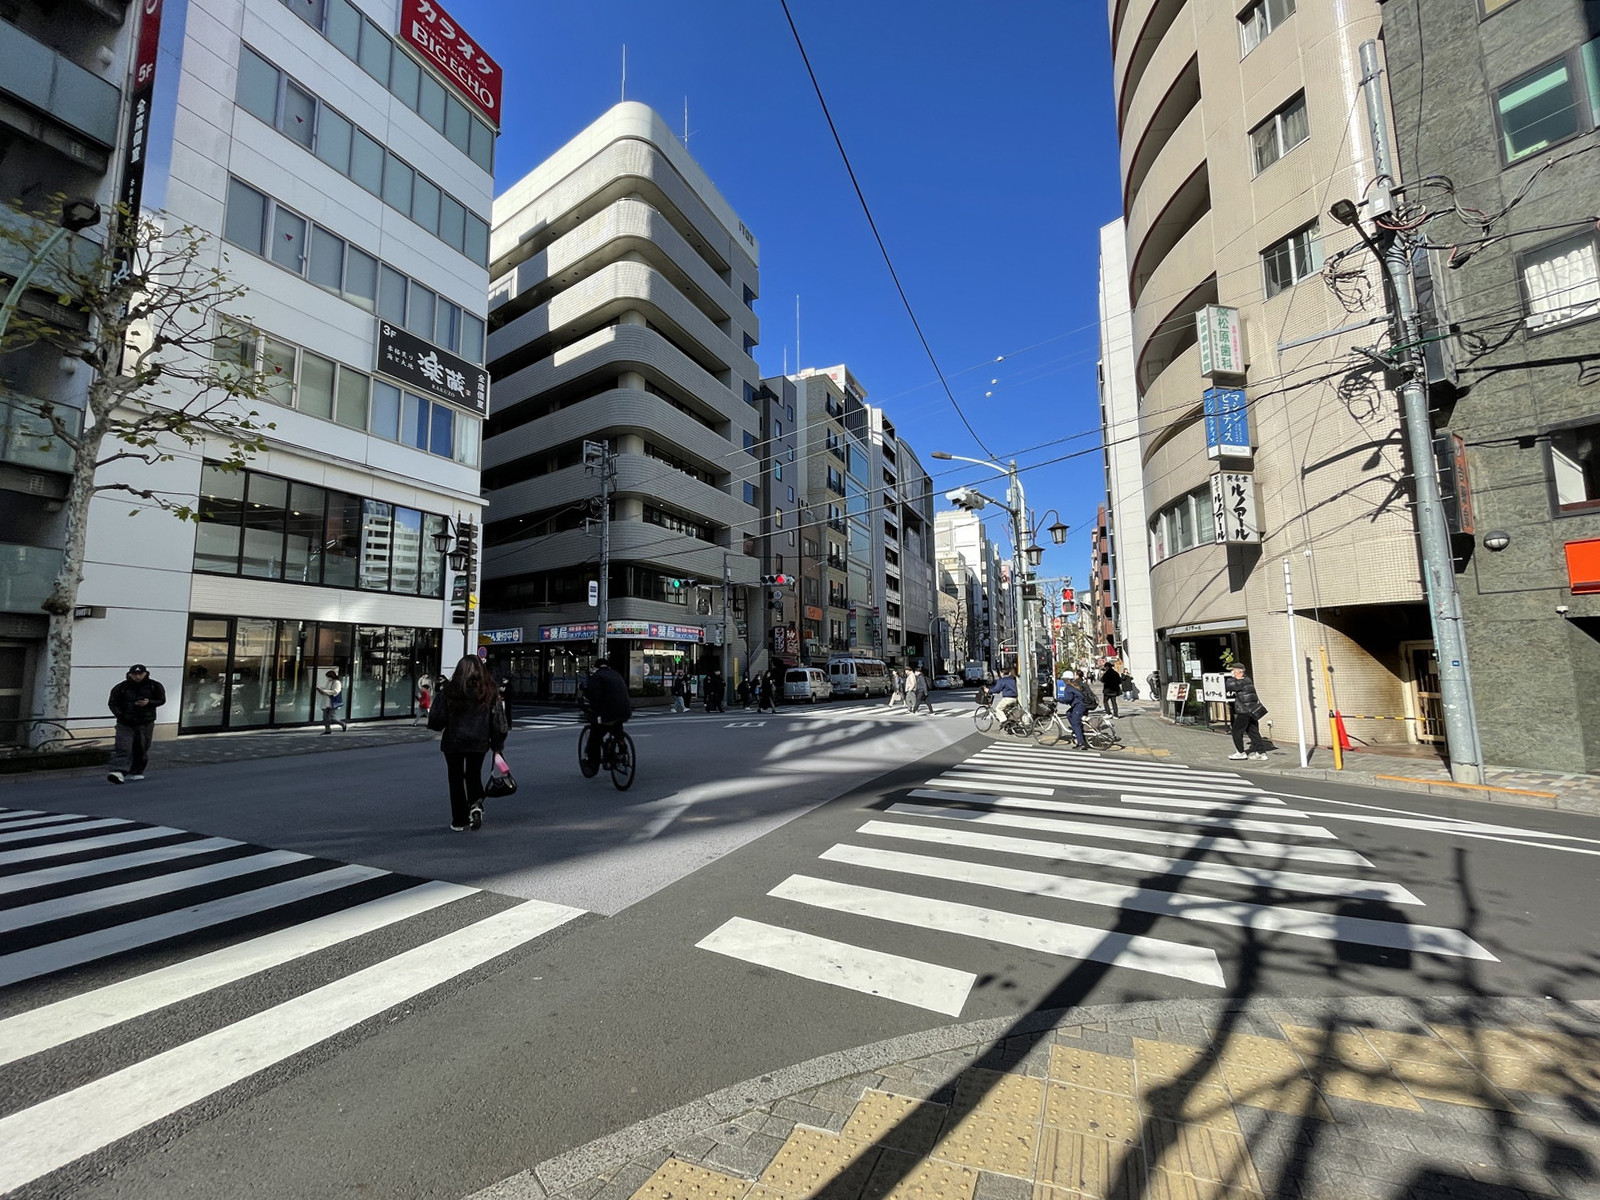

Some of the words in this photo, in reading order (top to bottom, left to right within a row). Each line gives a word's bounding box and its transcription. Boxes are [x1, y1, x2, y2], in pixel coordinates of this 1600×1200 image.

[417, 0, 493, 74] カラオケ
[138, 63, 153, 83] 5F
[412, 20, 447, 62] BIG
[450, 57, 495, 108] ECHO
[383, 325, 397, 338] 3F
[1217, 316, 1233, 370] 松原歯科
[1222, 393, 1233, 442] ピラティス
[1231, 394, 1242, 422] マシン
[1214, 493, 1226, 540] ルノアール
[1231, 483, 1251, 541] ルノアール
[550, 626, 568, 640] 薬局
[657, 625, 675, 638] 薬局
